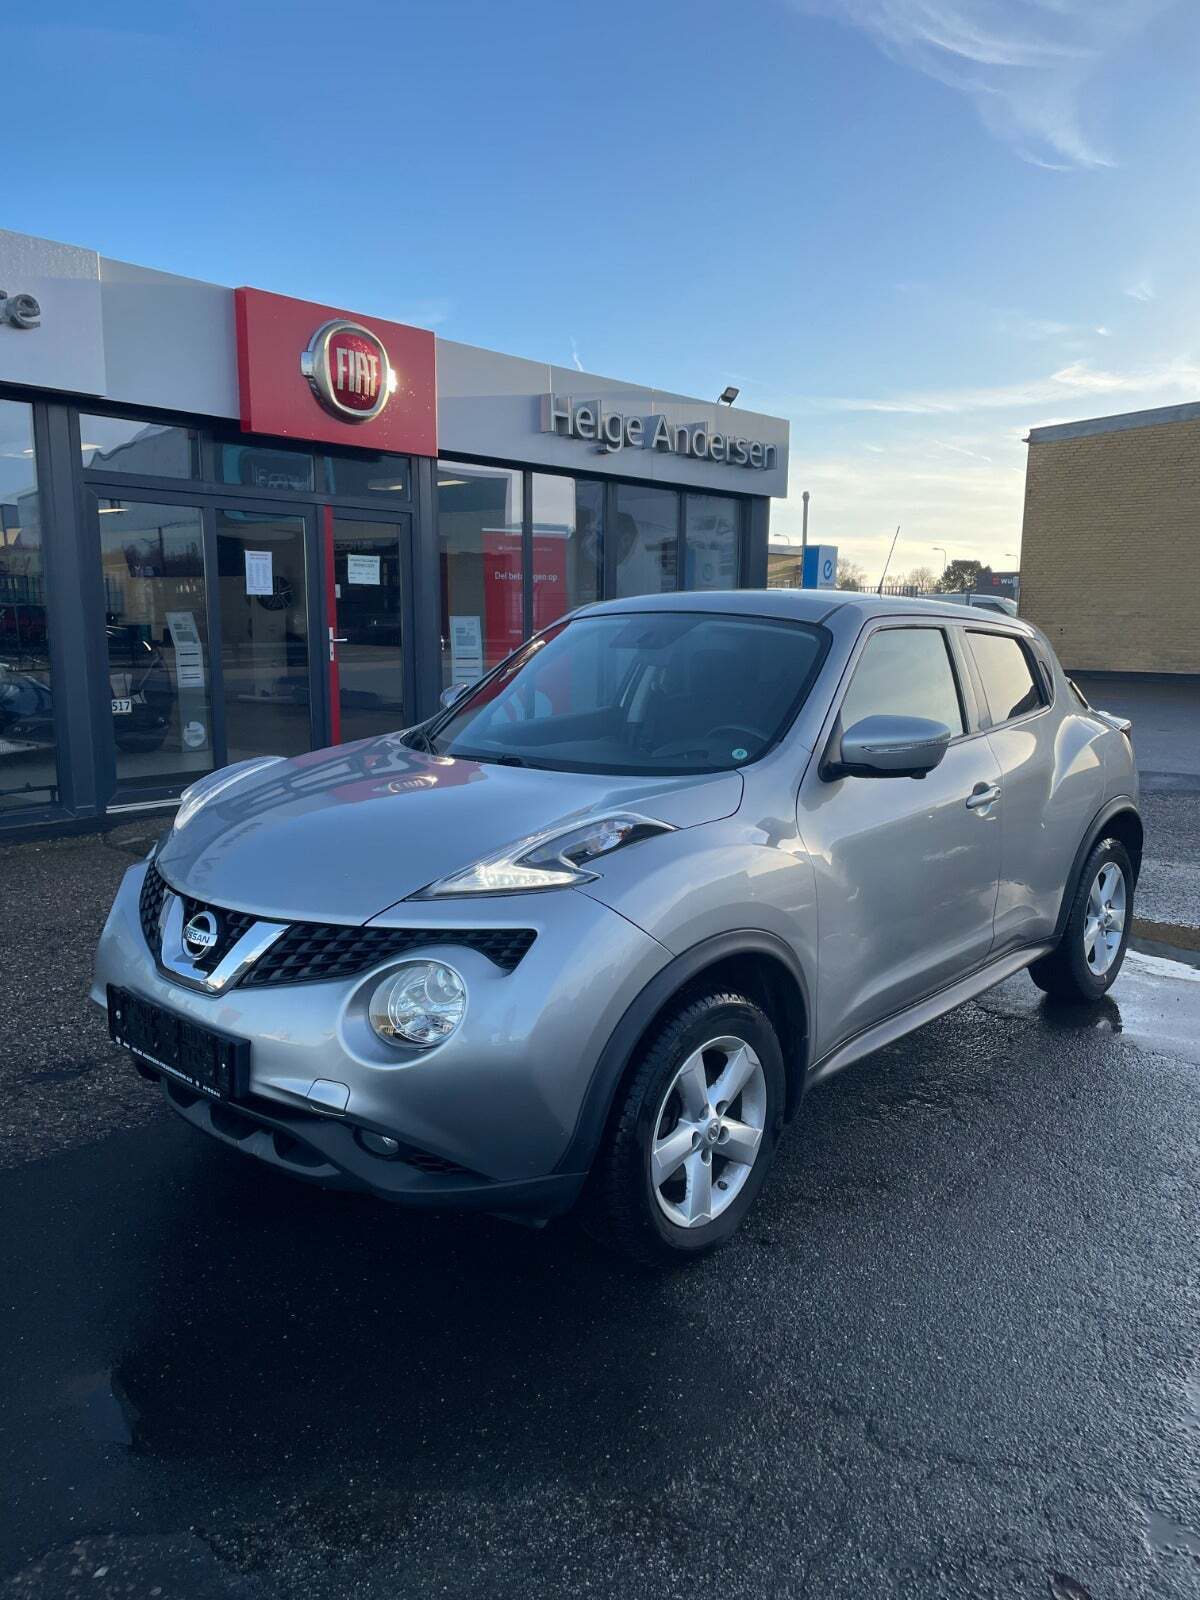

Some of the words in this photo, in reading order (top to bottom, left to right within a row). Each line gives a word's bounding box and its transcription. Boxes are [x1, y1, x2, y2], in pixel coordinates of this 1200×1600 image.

[0, 290, 41, 330] e
[336, 347, 379, 397] FIAT
[549, 392, 645, 452] Helge
[651, 414, 777, 470] Andersen
